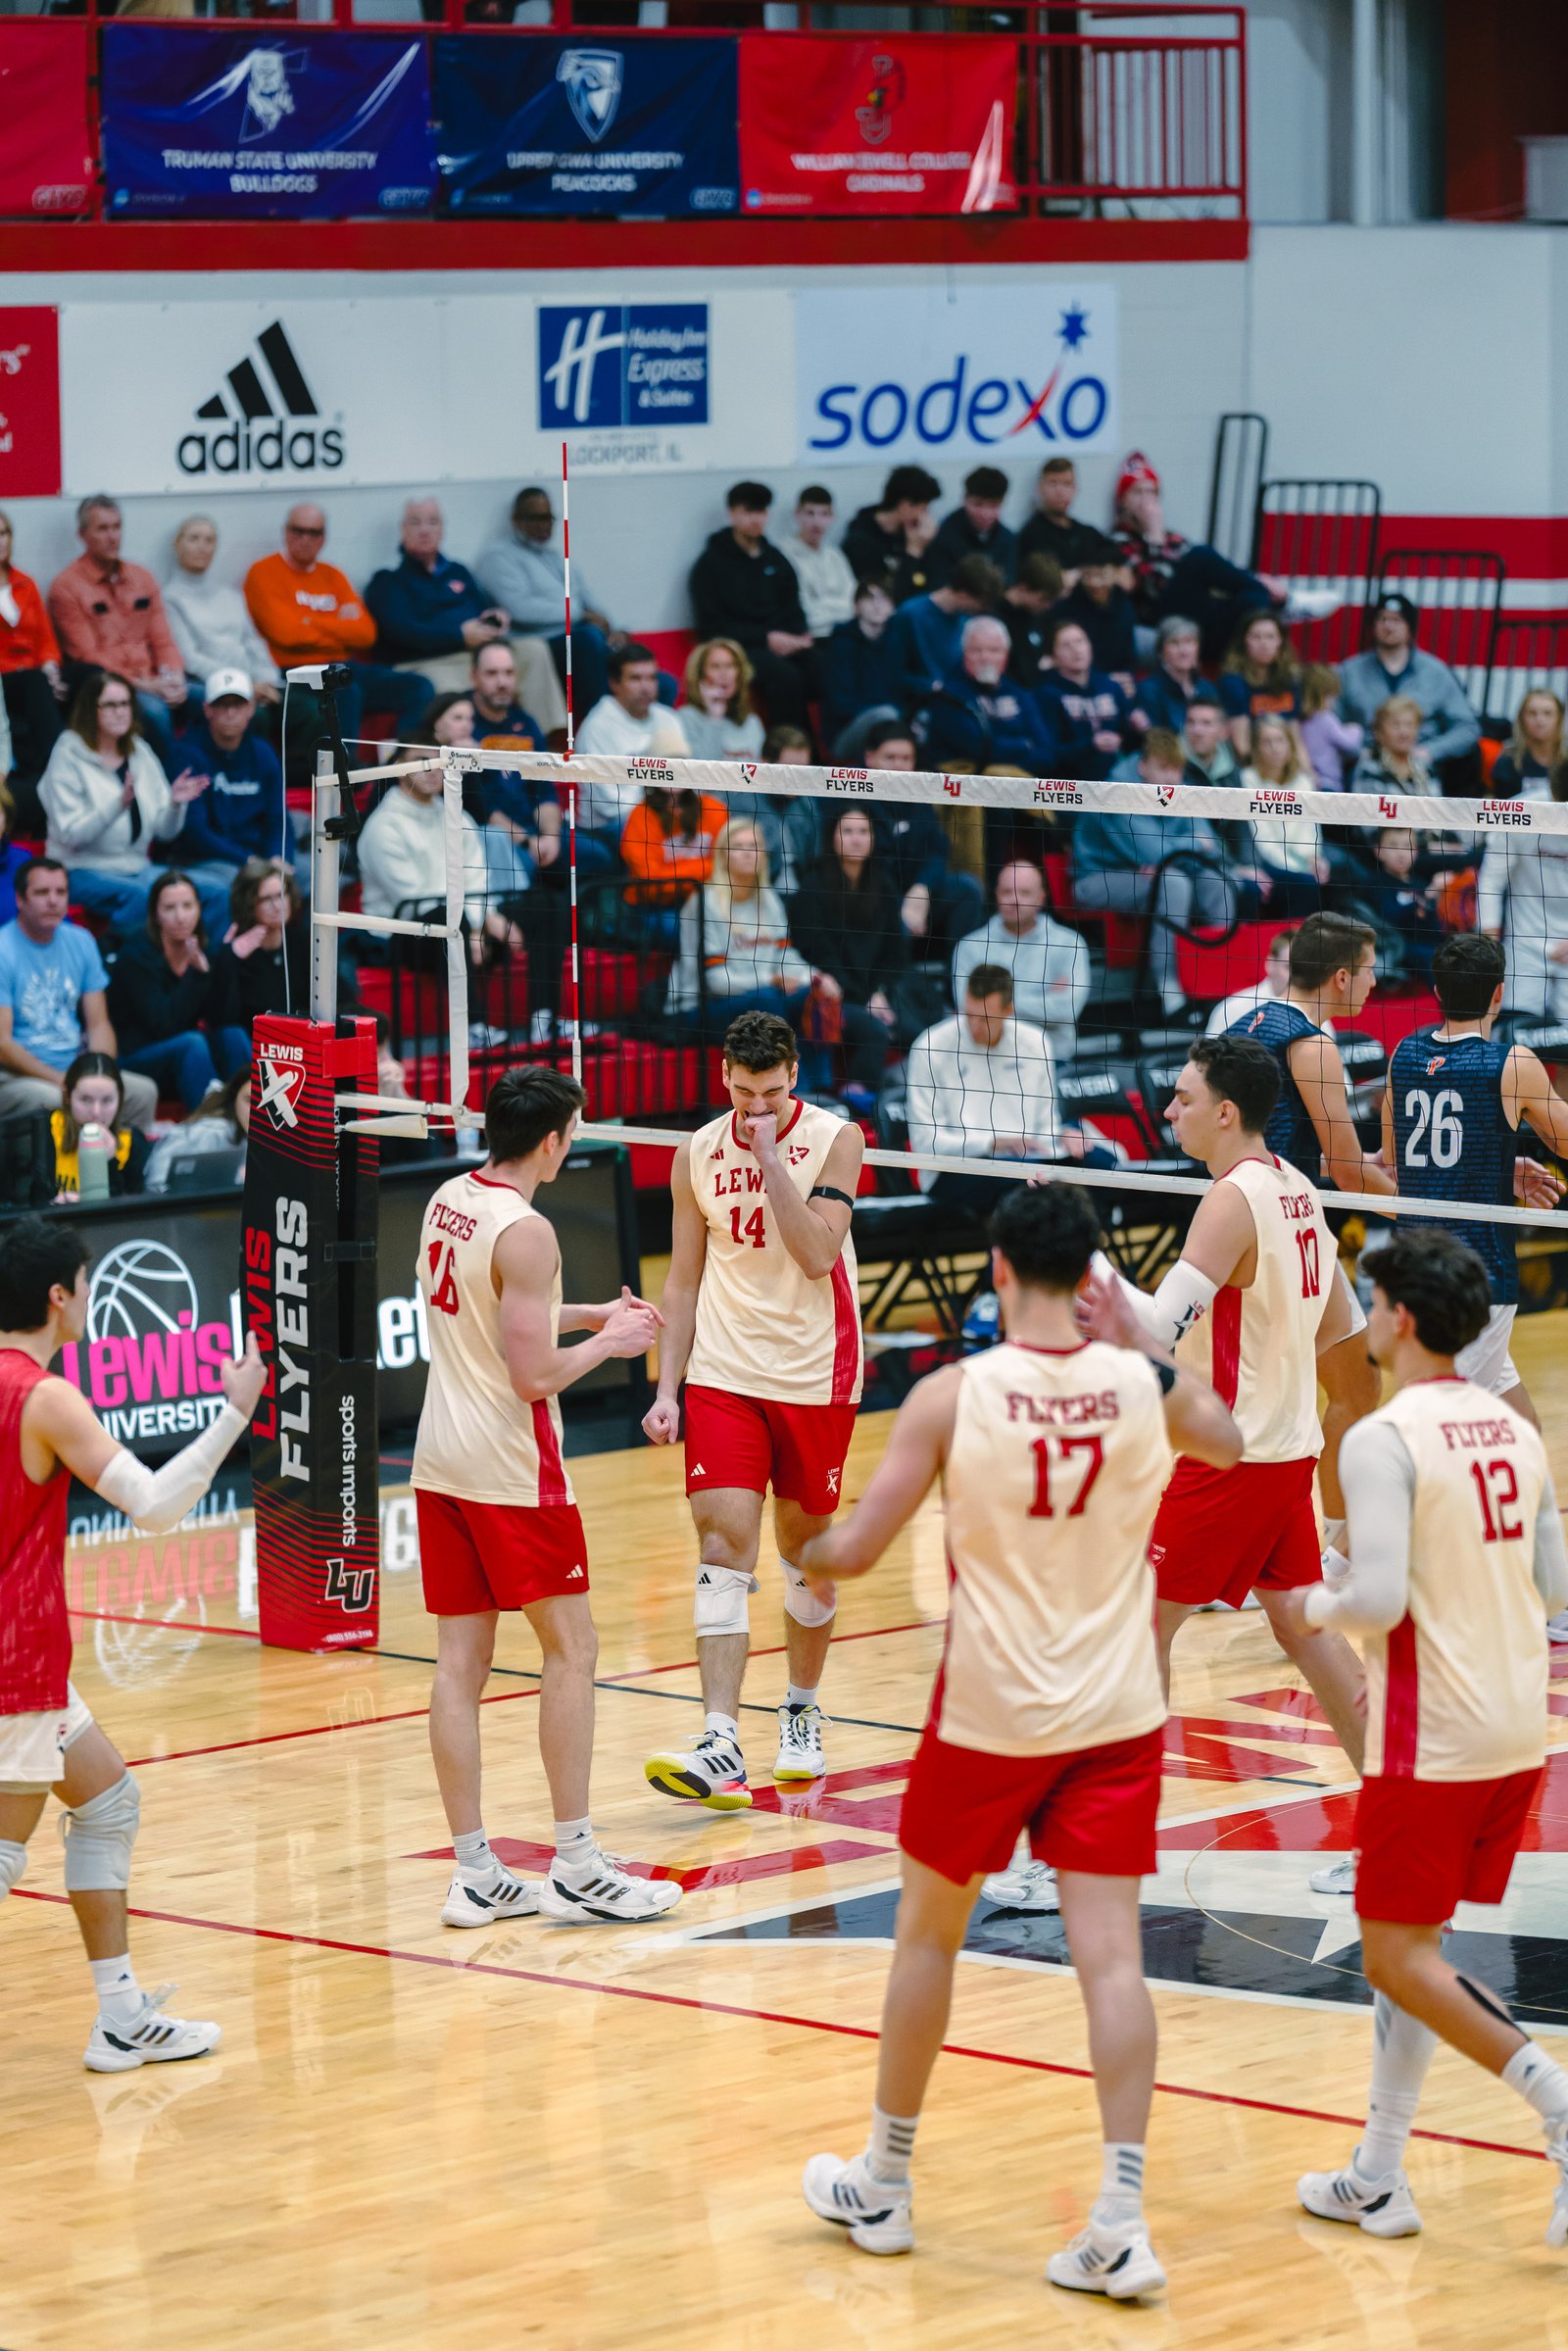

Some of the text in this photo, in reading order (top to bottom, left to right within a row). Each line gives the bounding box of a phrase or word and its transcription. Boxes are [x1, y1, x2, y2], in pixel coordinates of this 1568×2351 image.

[162, 149, 377, 171] TRUMAN STATE UNIVERSITY
[594, 152, 685, 170] UNIVERSITY
[627, 353, 705, 386] Express
[808, 355, 1107, 449] sodexo
[178, 418, 344, 473] adidas
[627, 768, 674, 781] FLYERS
[631, 758, 667, 769] LEWIS
[831, 768, 868, 780] LEWIS
[826, 779, 874, 793] FLYERS
[943, 774, 961, 798] LU
[1033, 791, 1083, 804] FLYERS
[1038, 780, 1076, 792] LEWIS
[1255, 790, 1296, 803] LEWIS
[1250, 801, 1302, 815] FLYERS
[1378, 795, 1398, 819] LU
[1476, 811, 1532, 826] FLYERS
[1483, 800, 1525, 812] LEWIS
[260, 1043, 304, 1061] LEWIS
[1404, 1089, 1464, 1169] 26
[714, 1167, 769, 1198] LEW
[428, 1202, 477, 1242] FLYERS
[1278, 1193, 1315, 1219] FLYERS
[729, 1206, 766, 1249] 14
[427, 1240, 460, 1316] 16
[1295, 1227, 1320, 1298] 10
[275, 1196, 310, 1483] FLYERS
[63, 1309, 232, 1408] Lewis
[101, 1395, 229, 1442] IVERSIT
[1005, 1390, 1120, 1425] FLYERS
[340, 1395, 356, 1462] sports
[1439, 1418, 1516, 1451] FLYERS
[1027, 1434, 1104, 1518] 17
[339, 1464, 356, 1547] imports
[1470, 1458, 1524, 1543] 12
[324, 1557, 375, 1614] LU
